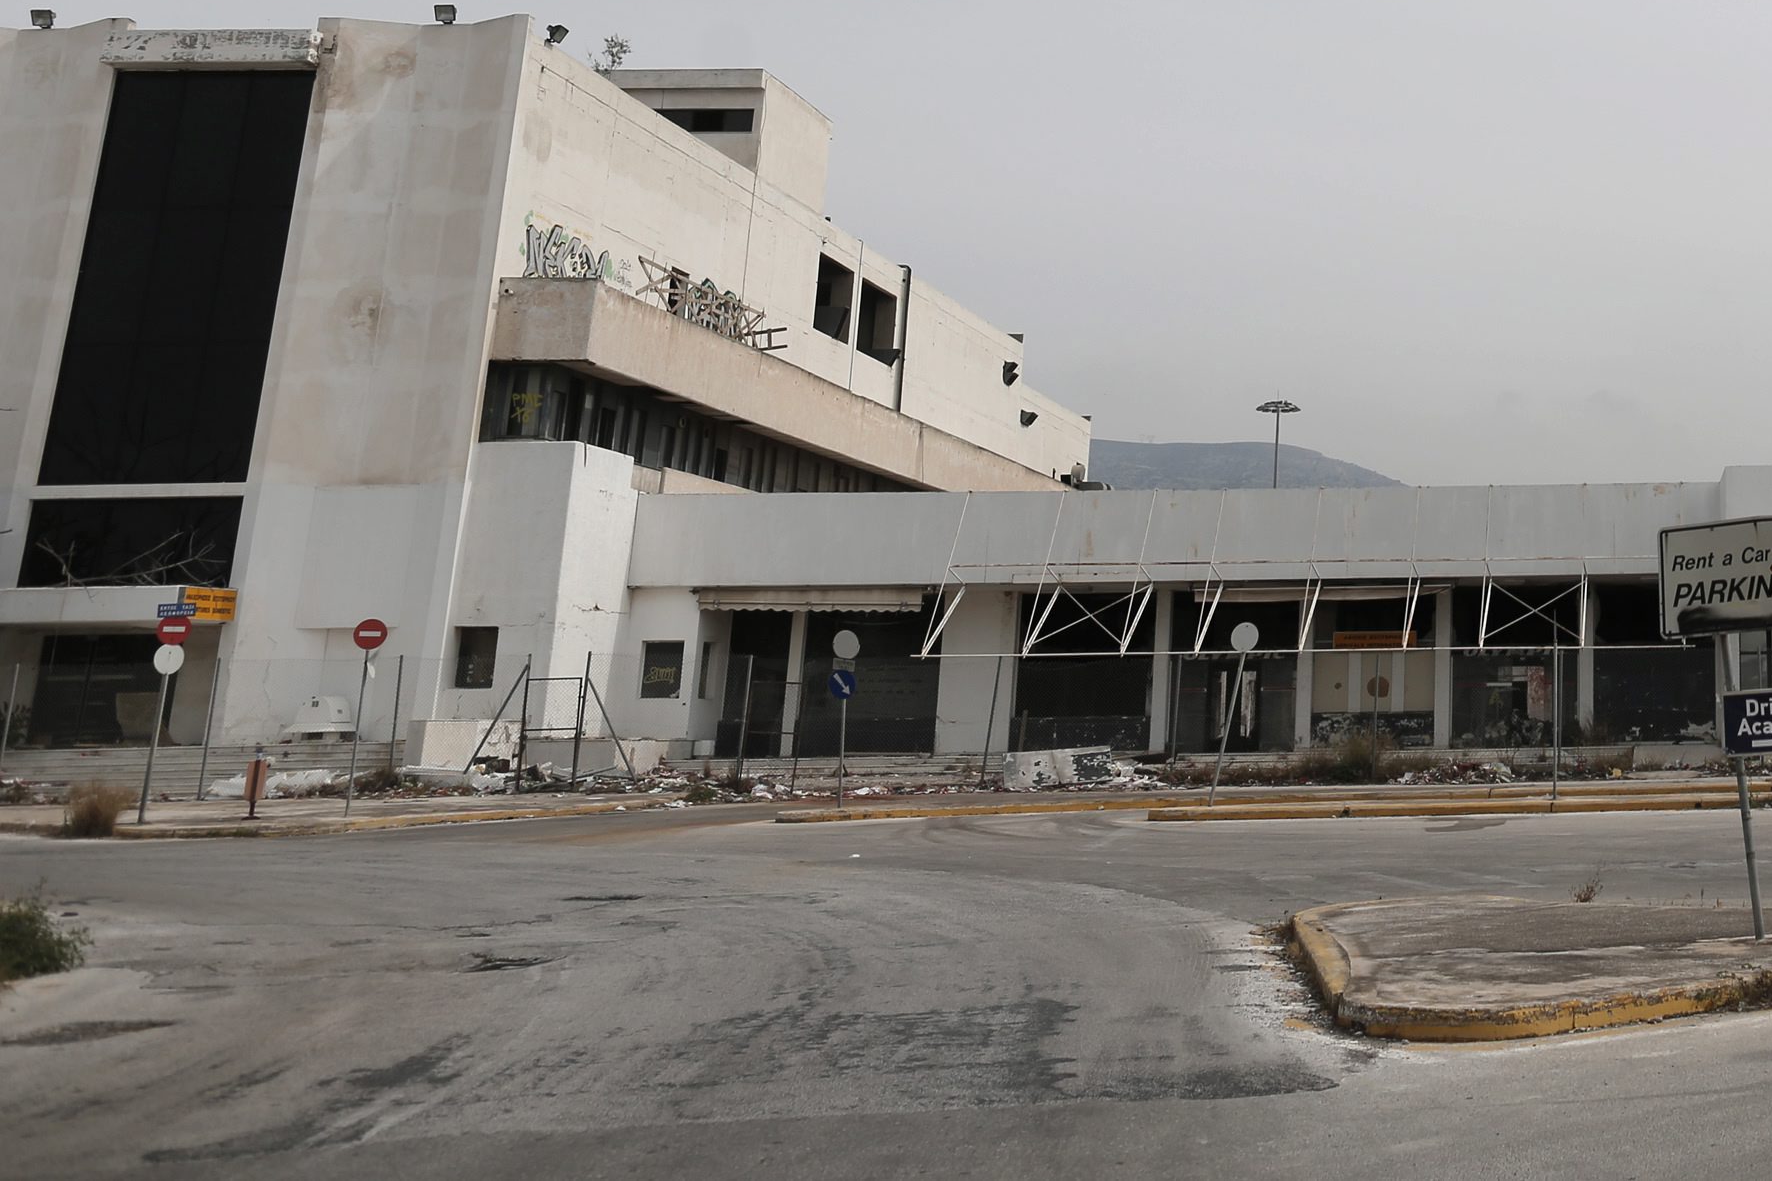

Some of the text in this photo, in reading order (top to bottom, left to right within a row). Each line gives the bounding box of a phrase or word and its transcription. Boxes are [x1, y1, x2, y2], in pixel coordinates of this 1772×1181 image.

[1672, 546, 1771, 572] Rent a Car
